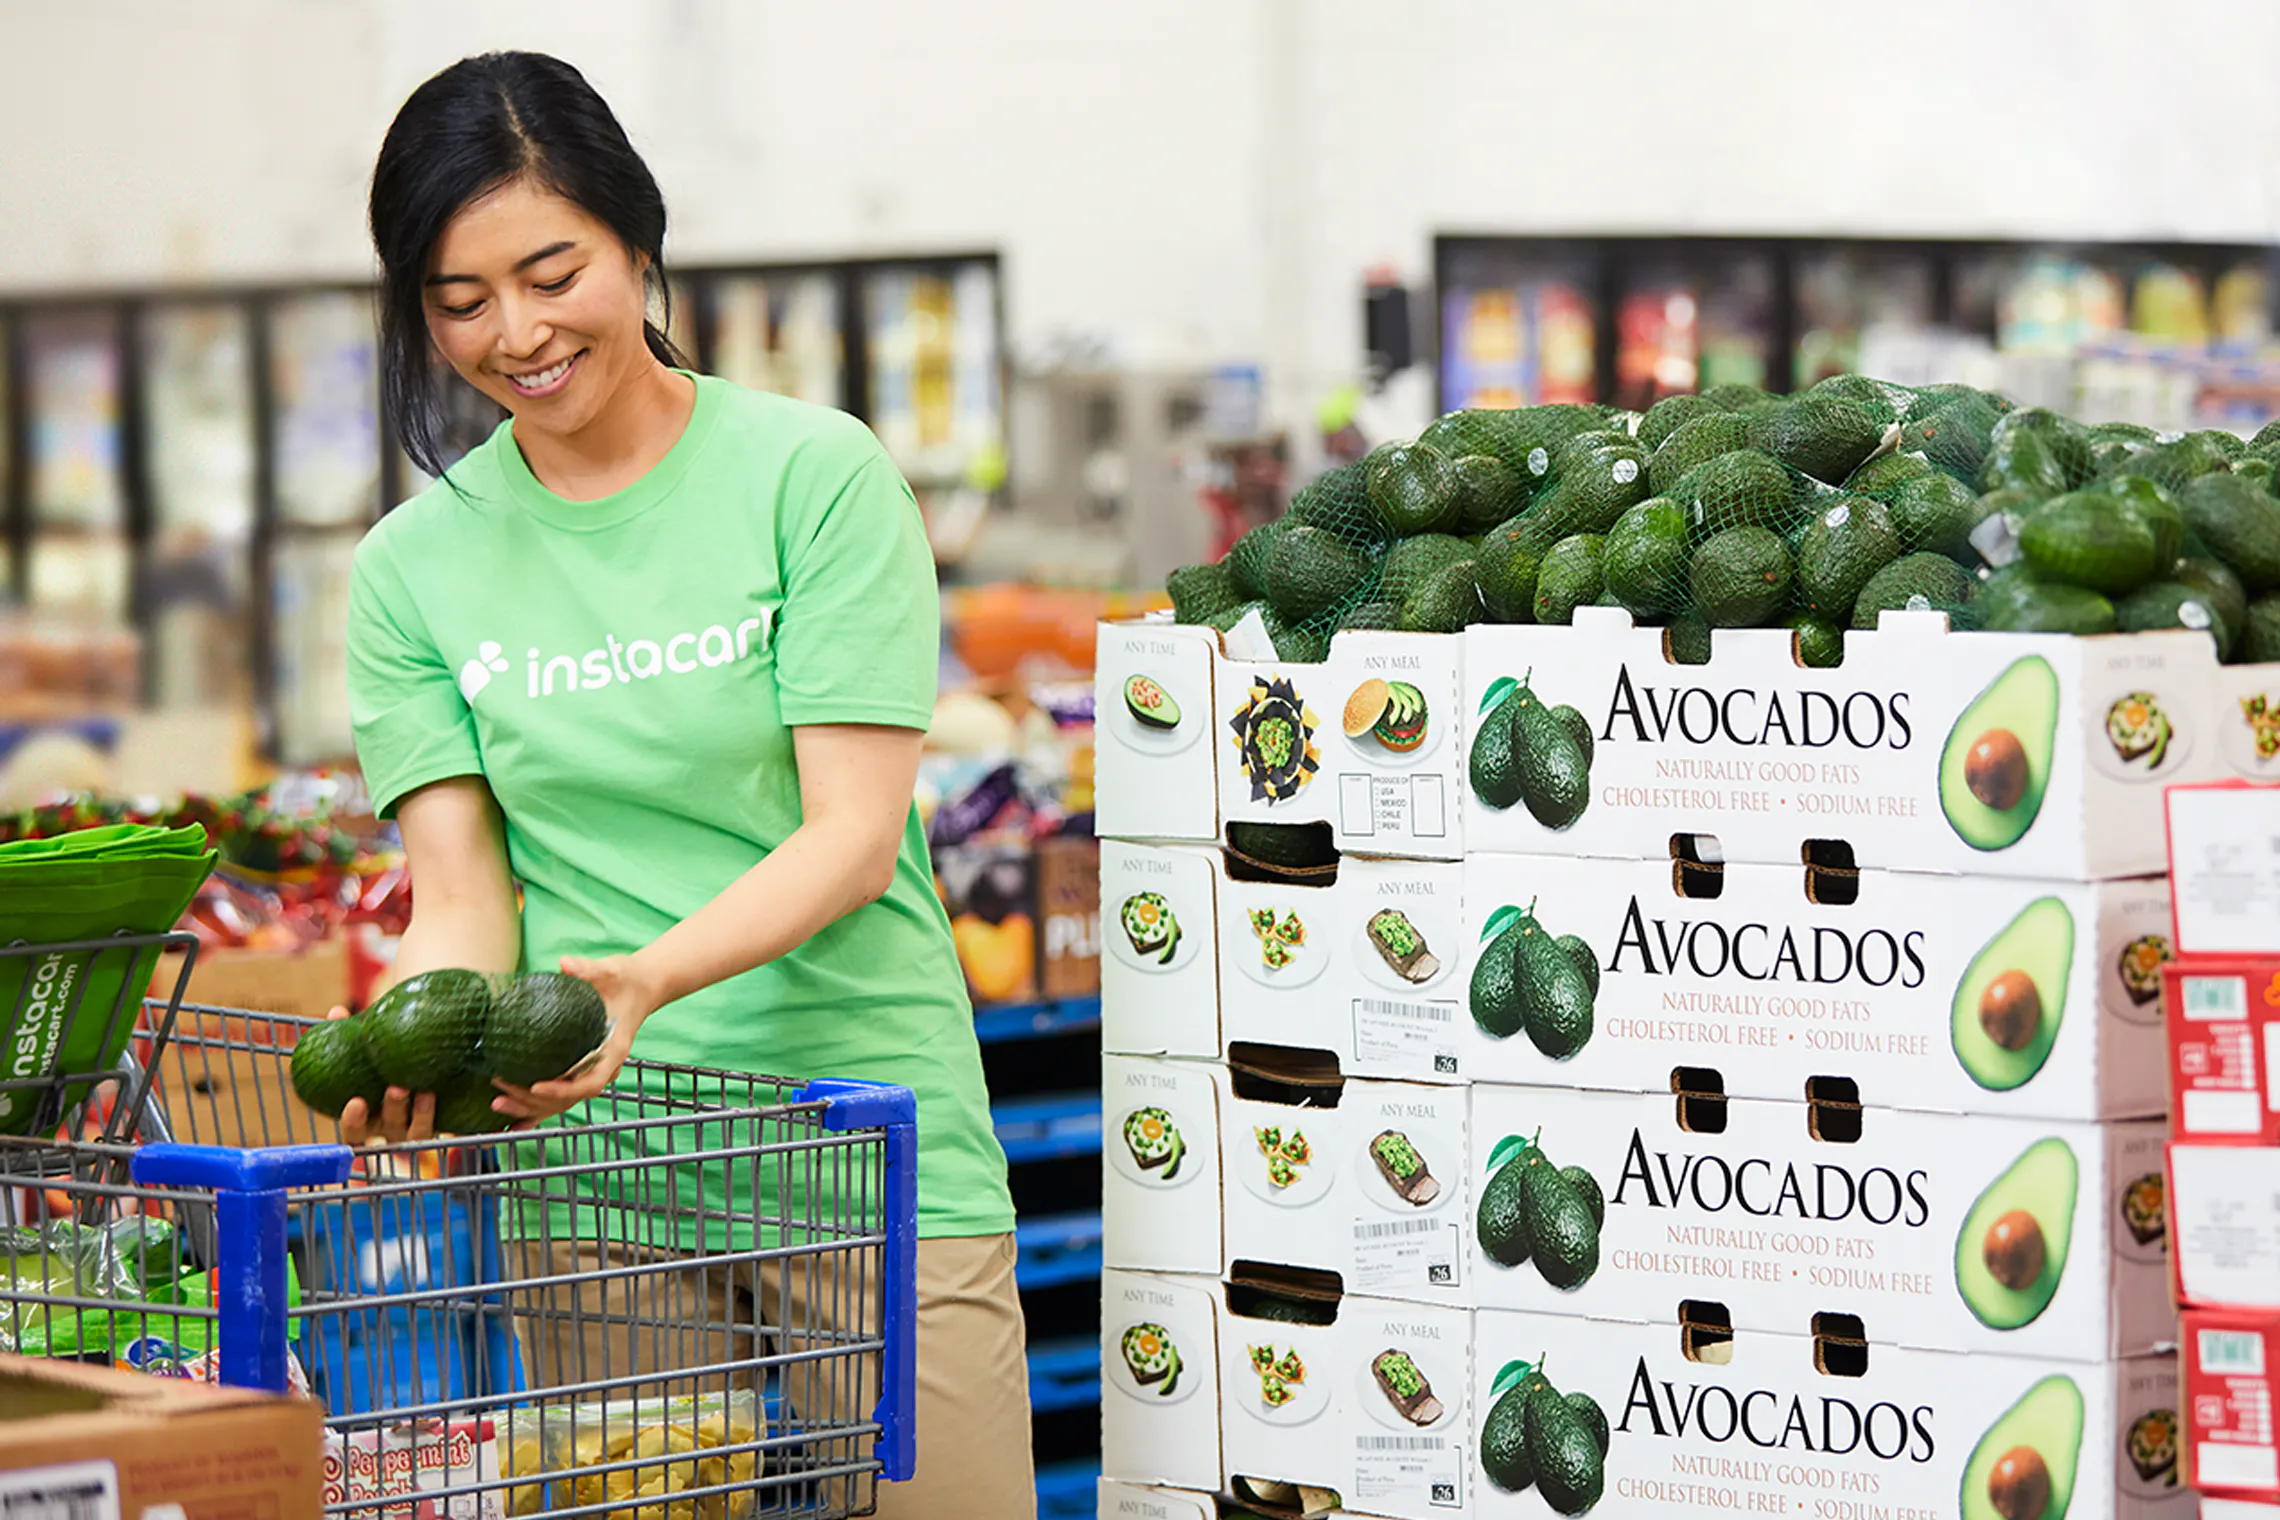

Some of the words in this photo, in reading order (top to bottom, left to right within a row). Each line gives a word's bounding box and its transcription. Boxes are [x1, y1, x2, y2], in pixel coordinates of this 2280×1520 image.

[1124, 641, 1145, 653] ANY
[1150, 642, 1175, 656] TIME
[1365, 657, 1387, 668] ANY
[1391, 656, 1420, 668] MEAL
[1656, 759, 1754, 780] NATURALLY
[1759, 762, 1815, 783] GOOD
[1822, 764, 1859, 784] FATS
[1381, 799, 1405, 807] MEXICO
[1603, 787, 1725, 809] CHOLESTEROL
[1731, 791, 1769, 811] FREE
[1797, 793, 1871, 815] SODIUM
[1878, 796, 1917, 817] FREE
[1122, 859, 1142, 871] ANY
[1147, 860, 1172, 874] TIME
[1378, 883, 1401, 894] ANY
[1405, 882, 1434, 895] MEAL
[1663, 992, 1763, 1015] NATURALLY
[1768, 997, 1826, 1019] GOOD
[1833, 1001, 1870, 1021] FATS
[1607, 1018, 1731, 1043] CHOLESTEROL
[1739, 1026, 1777, 1046] FREE
[1805, 1029, 1881, 1052] SODIUM
[1888, 1034, 1928, 1055] FREE
[1125, 1074, 1146, 1086] ANY
[1151, 1075, 1176, 1090] TIME
[1381, 1104, 1403, 1116] ANY
[1407, 1105, 1436, 1118] MEAL
[1668, 1225, 1766, 1250] NATURALLY
[1771, 1233, 1829, 1255] GOOD
[1836, 1238, 1874, 1259] FATS
[1612, 1249, 1735, 1278] CHOLESTEROL
[1743, 1260, 1781, 1282] FREE
[1809, 1266, 1885, 1291] SODIUM
[1892, 1273, 1932, 1295] FREE
[1123, 1290, 1143, 1302] ANY
[1147, 1291, 1173, 1306] TIME
[1383, 1323, 1407, 1336] ANY
[1411, 1325, 1440, 1339] MEAL
[1673, 1454, 1772, 1482] NATURALLY
[1777, 1465, 1835, 1488] GOOD
[1842, 1471, 1879, 1493] FATS
[1617, 1478, 1743, 1509] CHOLESTEROL
[1748, 1492, 1786, 1514] FREE
[1119, 1500, 1138, 1513] ANY
[1143, 1503, 1166, 1519] TIME
